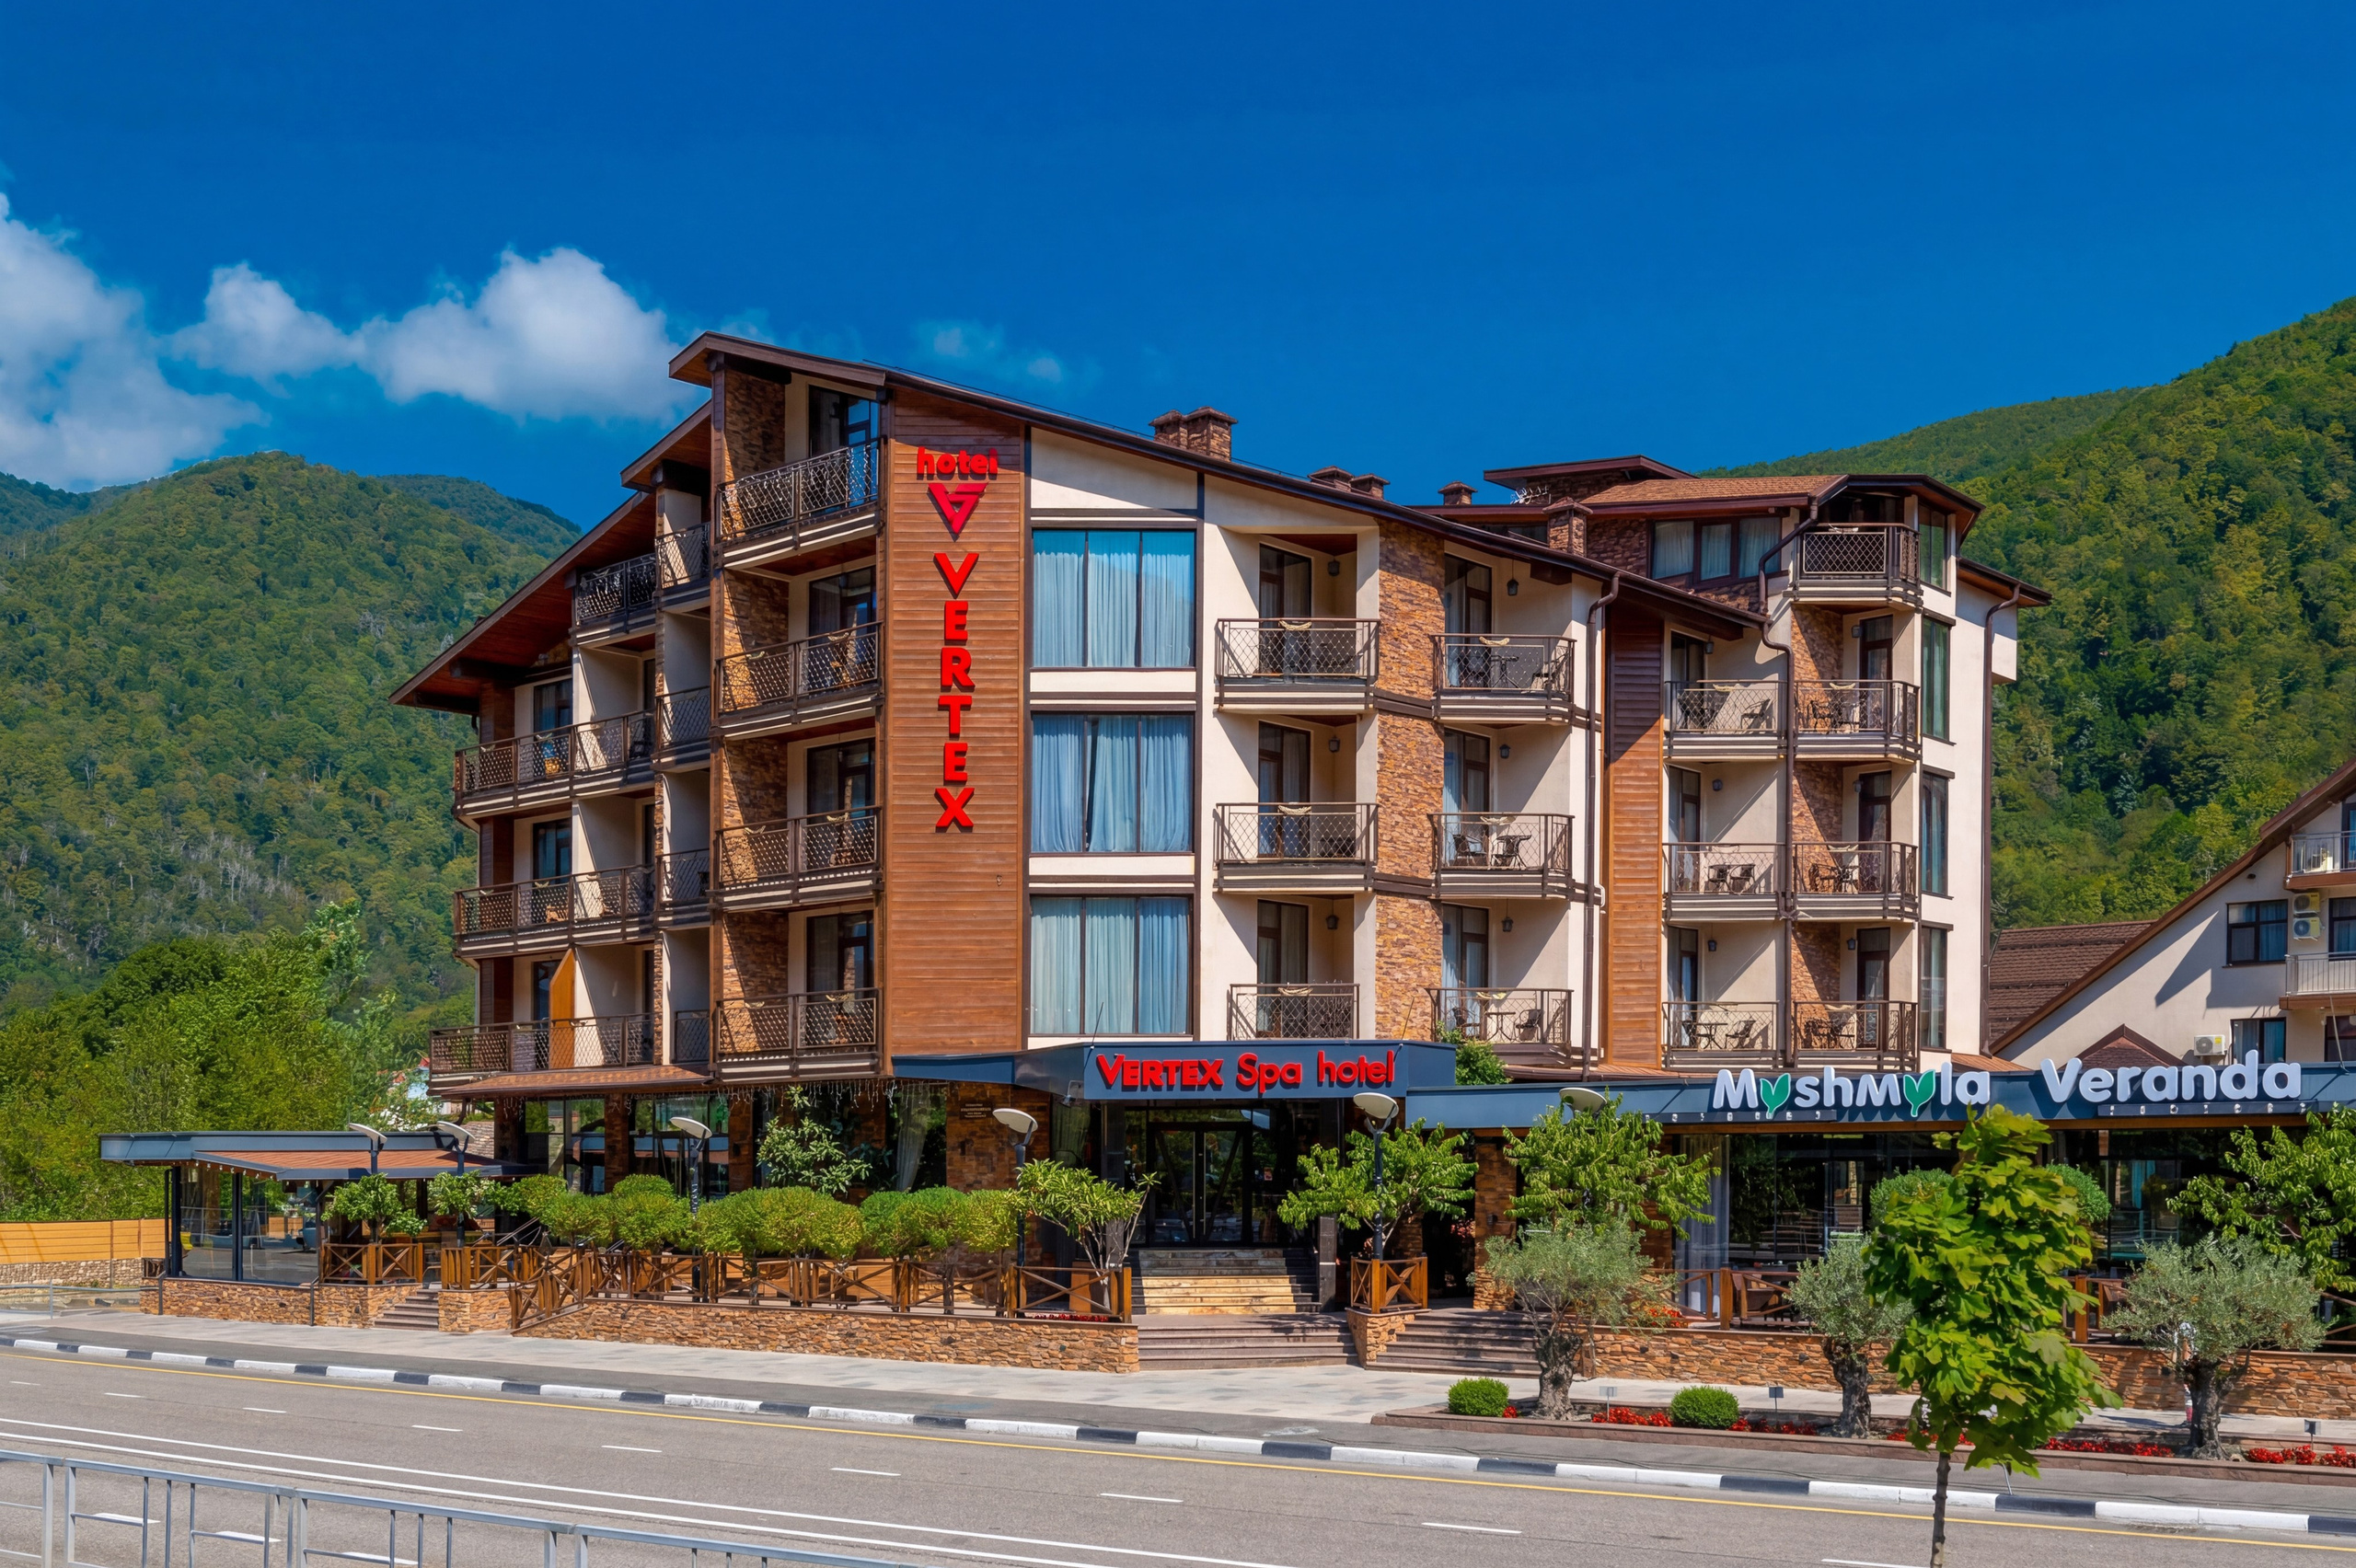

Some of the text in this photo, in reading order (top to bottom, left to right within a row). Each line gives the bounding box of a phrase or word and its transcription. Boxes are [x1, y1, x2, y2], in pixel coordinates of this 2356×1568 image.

[917, 445, 999, 475] hotel
[933, 552, 980, 828] VERTEX
[1096, 1050, 1395, 1094] VERTEX Spa hotel
[2039, 1049, 2301, 1103] Veranda
